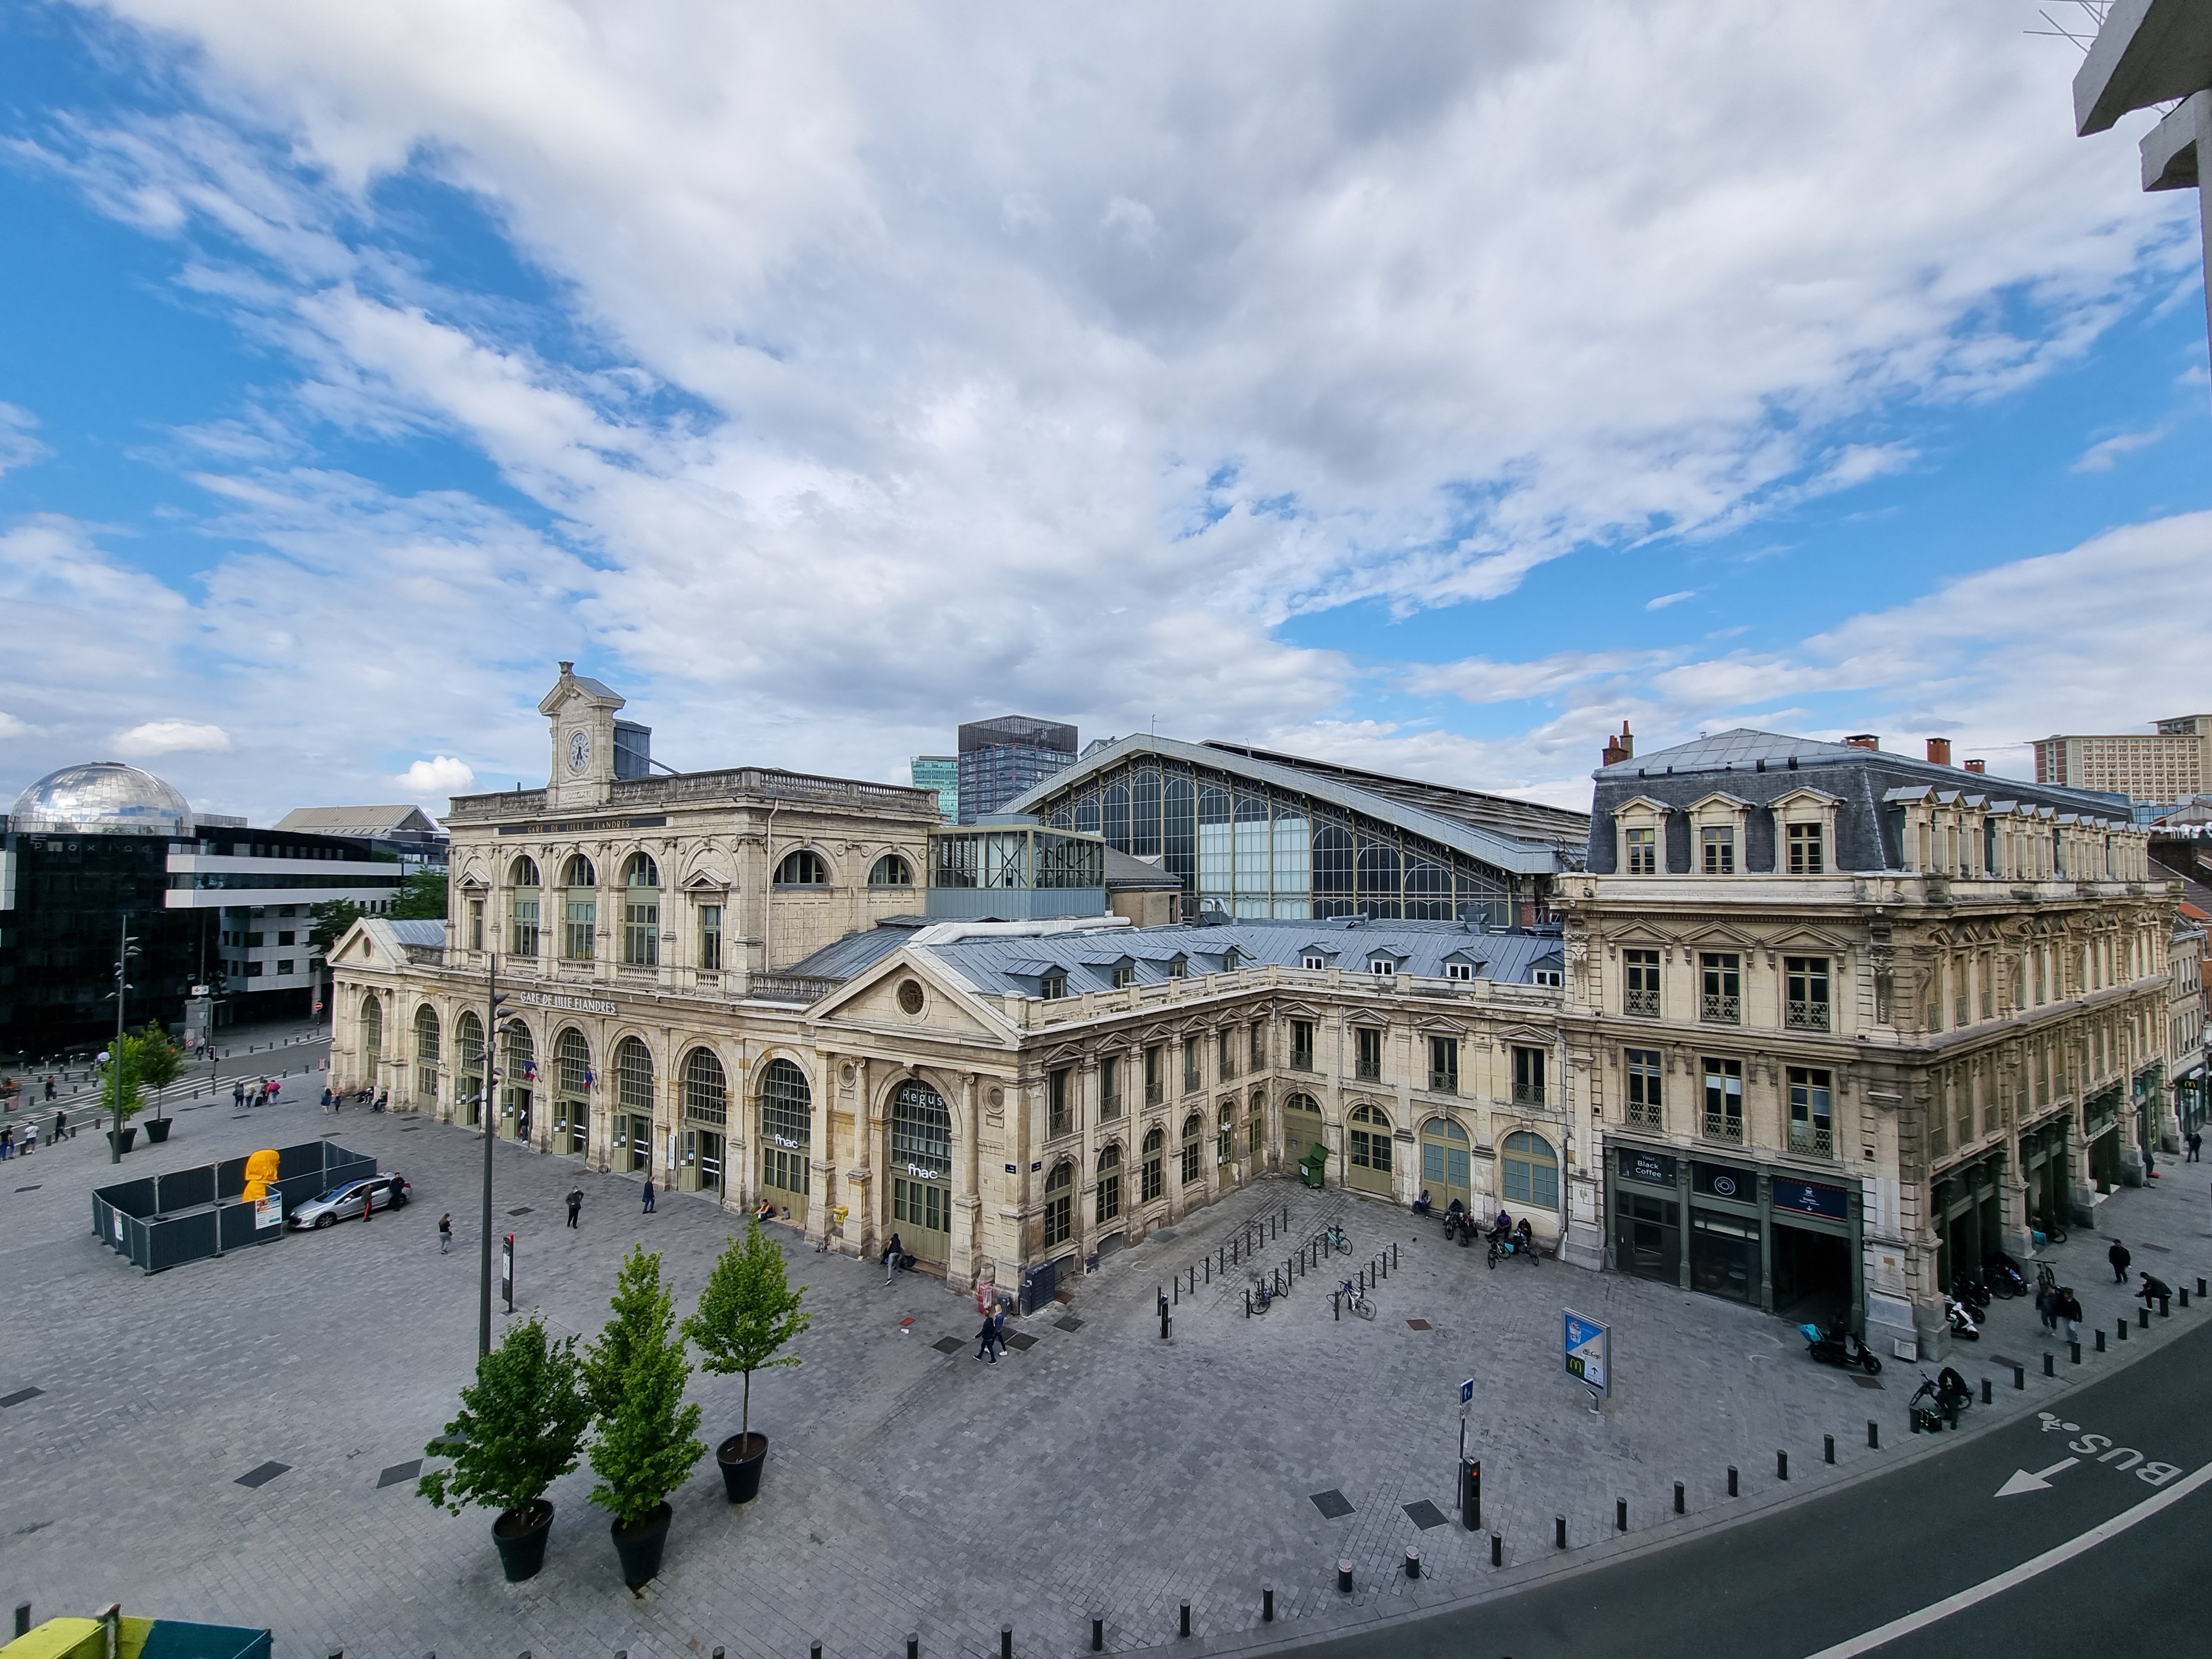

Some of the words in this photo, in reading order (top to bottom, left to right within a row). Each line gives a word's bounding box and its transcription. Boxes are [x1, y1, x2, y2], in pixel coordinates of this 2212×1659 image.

[566, 823, 584, 831] LILLE
[593, 820, 630, 829] FLANDRES
[521, 991, 540, 1003] GARE
[543, 994, 552, 1005] DE
[555, 996, 572, 1008] LILLE
[575, 998, 616, 1013] FLANDRES
[902, 1088, 943, 1107] Regus
[775, 1133, 799, 1149] fnac
[907, 1163, 938, 1180] fnac
[1635, 1167, 1662, 1178] Coffee
[1637, 1160, 1659, 1170] Black
[2069, 1434, 2183, 1486] BUS
